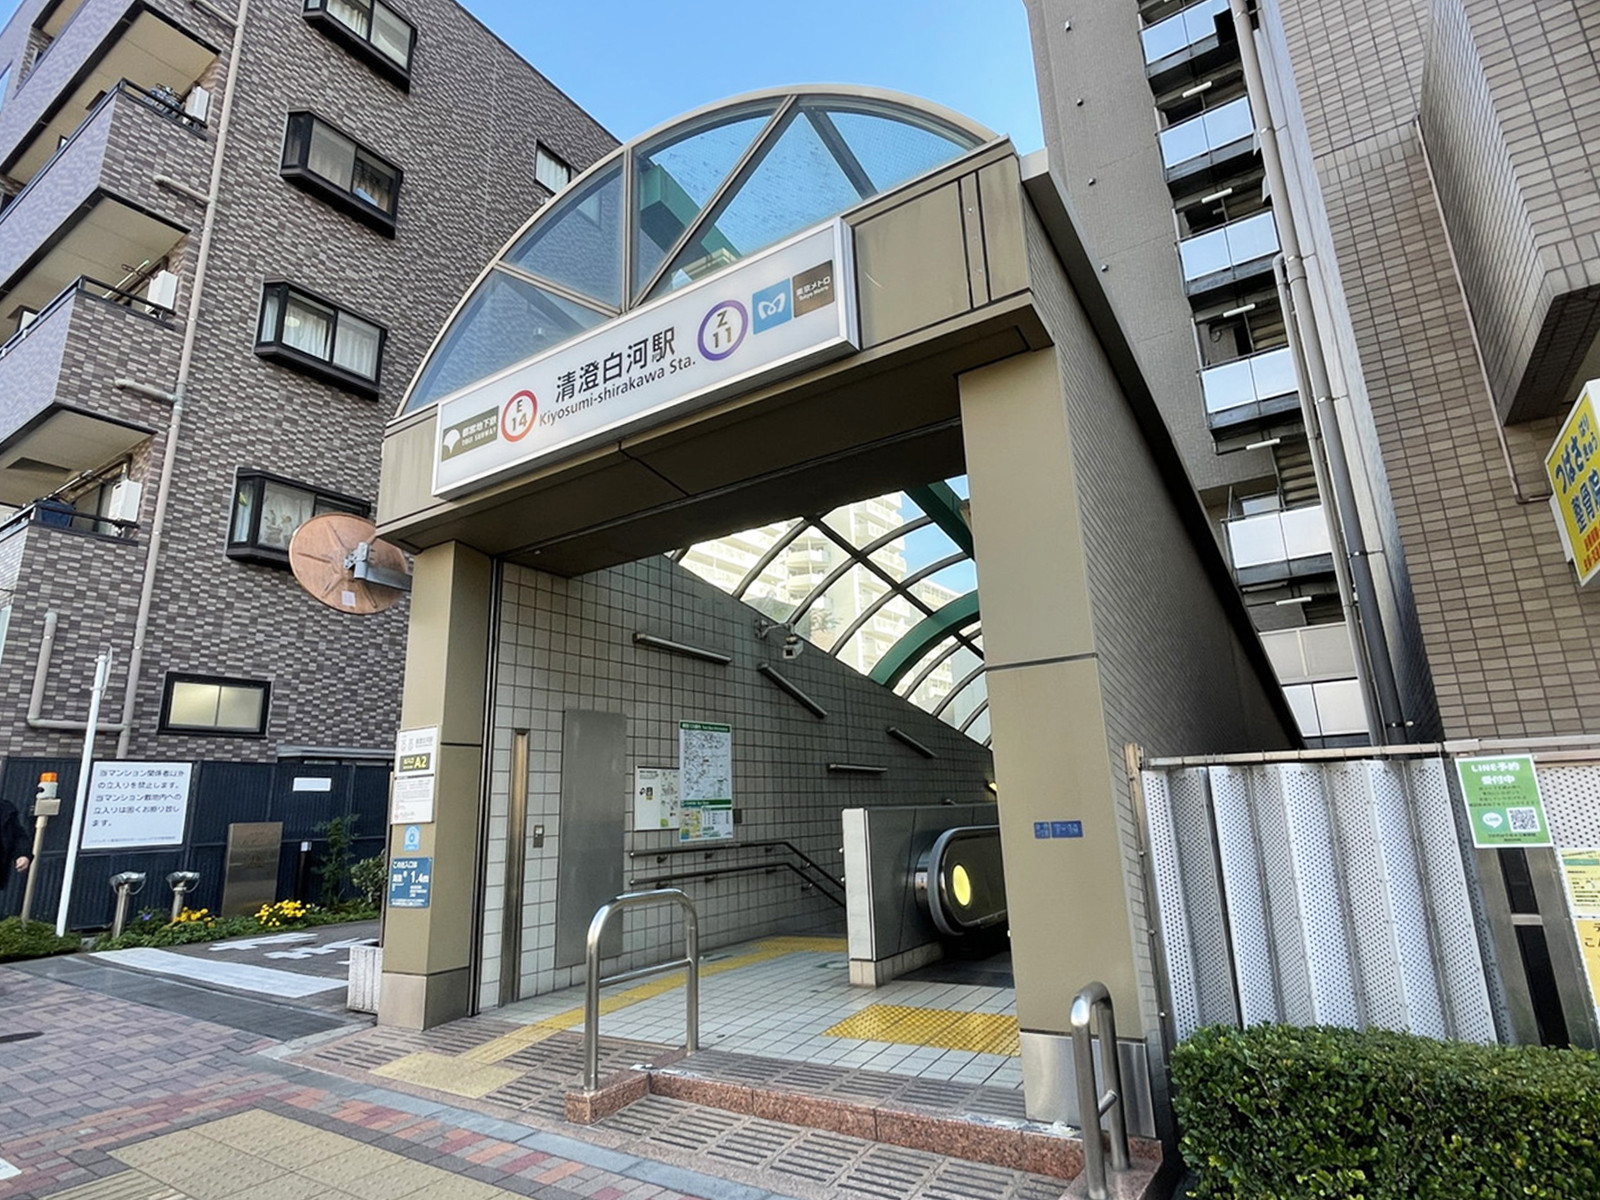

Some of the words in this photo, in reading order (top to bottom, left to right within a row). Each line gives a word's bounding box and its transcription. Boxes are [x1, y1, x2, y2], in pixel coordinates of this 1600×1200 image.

[716, 310, 728, 328] Z
[713, 327, 732, 348] 11
[555, 326, 676, 403] 清澄白河駅
[539, 367, 666, 426] Kiyosumi-shirakawa
[669, 356, 696, 374] Sta.
[516, 399, 524, 413] E
[511, 413, 528, 432] 14
[1555, 436, 1585, 494] つばさ
[414, 755, 428, 769] A2
